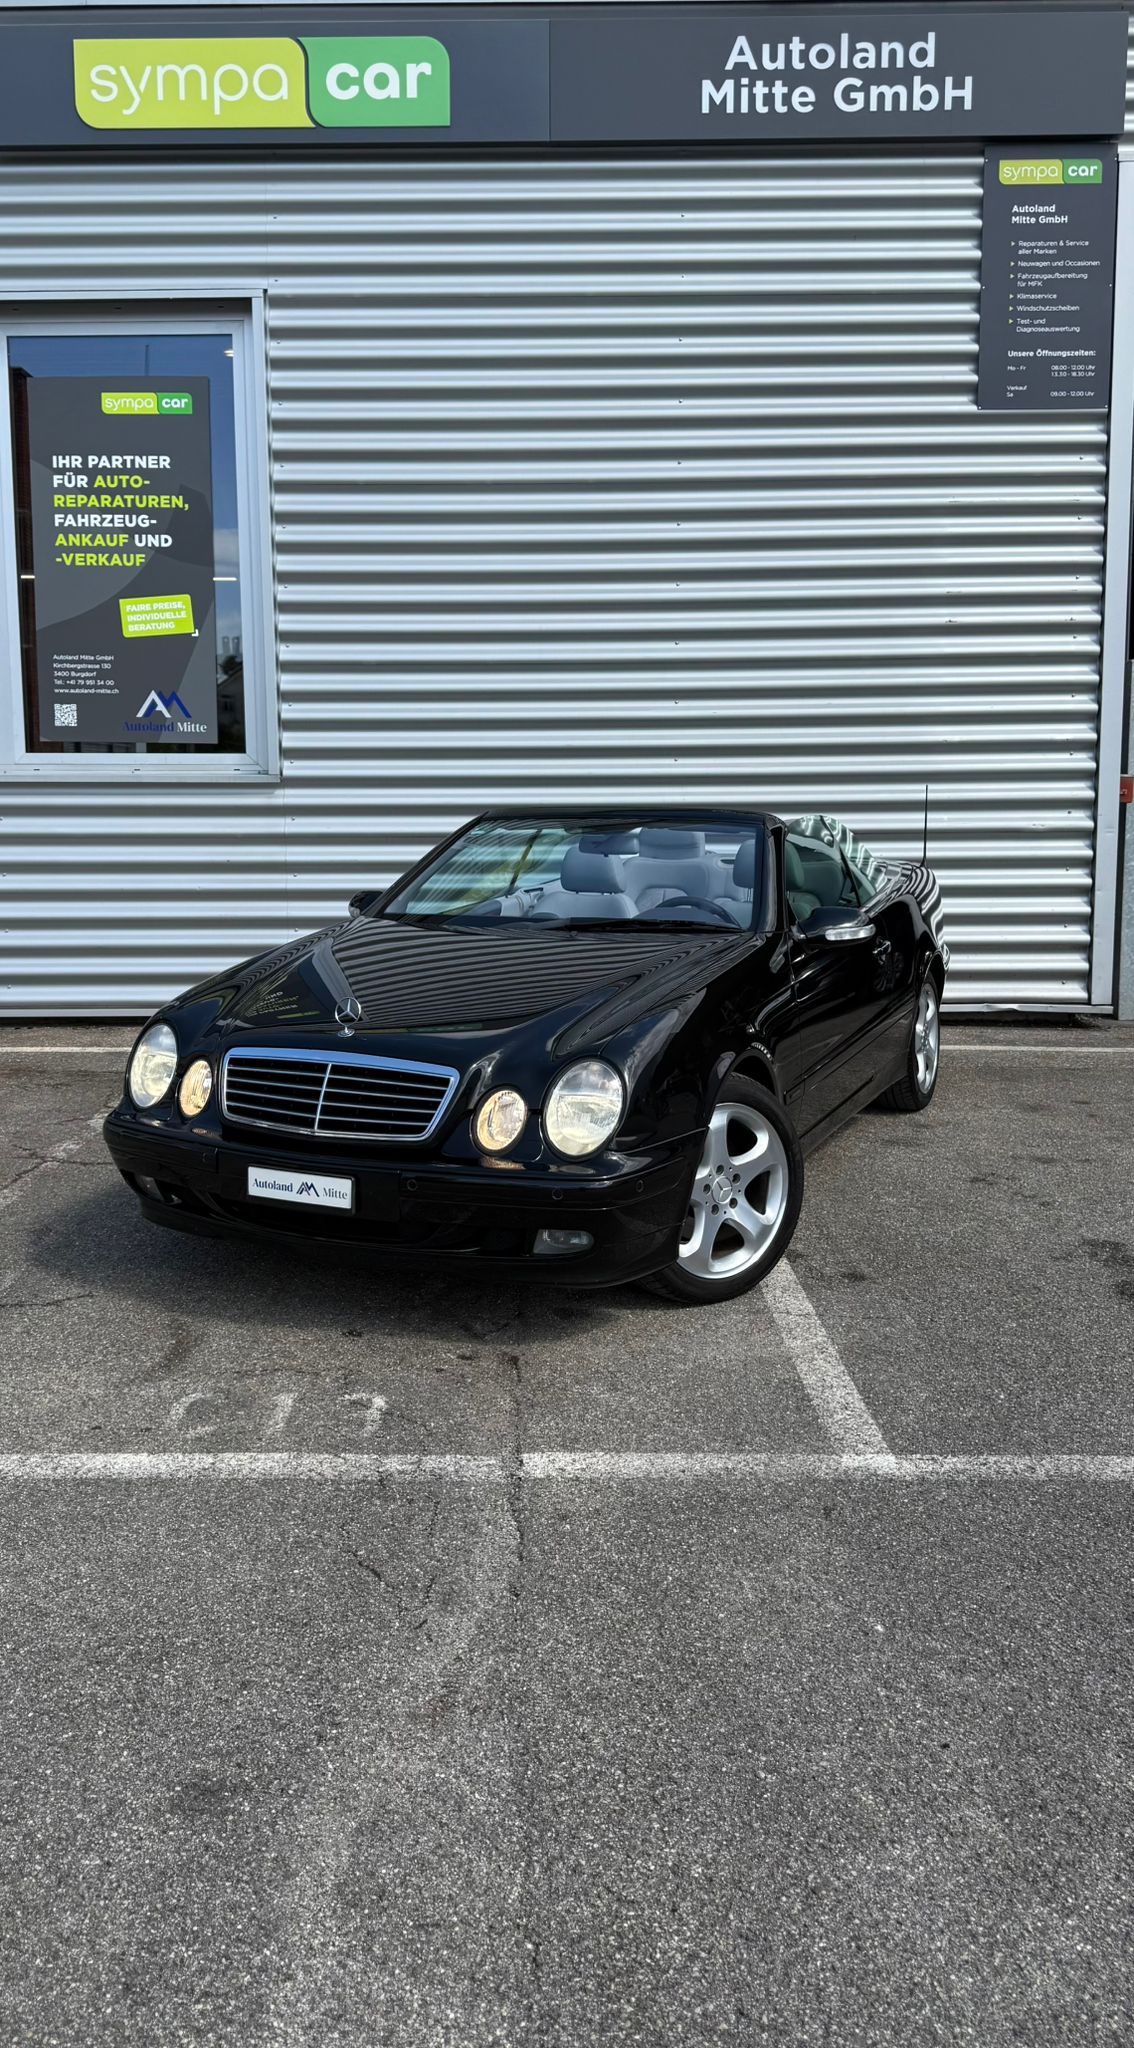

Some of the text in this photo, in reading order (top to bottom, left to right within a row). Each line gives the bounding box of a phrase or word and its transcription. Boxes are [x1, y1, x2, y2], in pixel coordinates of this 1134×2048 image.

[725, 32, 936, 71] Autoland
[90, 61, 431, 115] sympa car
[701, 76, 973, 114] Mitte GmbH
[1003, 165, 1098, 181] sympa car
[1012, 204, 1056, 213] Autoland
[1011, 215, 1068, 224] Mitte GmbH
[1018, 240, 1058, 248] Reparaturen
[1016, 325, 1080, 333] Diagnoseauswertung
[1036, 348, 1096, 358] Öffnungszeiten:
[105, 397, 188, 411] sympa car
[52, 455, 171, 469] IHR PARTNER
[53, 472, 150, 488] FÜR AUTO-
[53, 494, 189, 511] REPARATUREN,
[54, 514, 157, 528] FAHRZEUG-
[55, 534, 173, 547] ANKAUF UND
[56, 553, 146, 567] -VERKAUF
[126, 601, 186, 612] FAIRE PREISE,
[127, 611, 187, 622] INDIVIDUELLE
[128, 622, 175, 632] BERATUNG
[122, 721, 208, 733] Autoland Mitte
[253, 1178, 293, 1192] Autoland
[323, 1187, 347, 1200] Mitte
